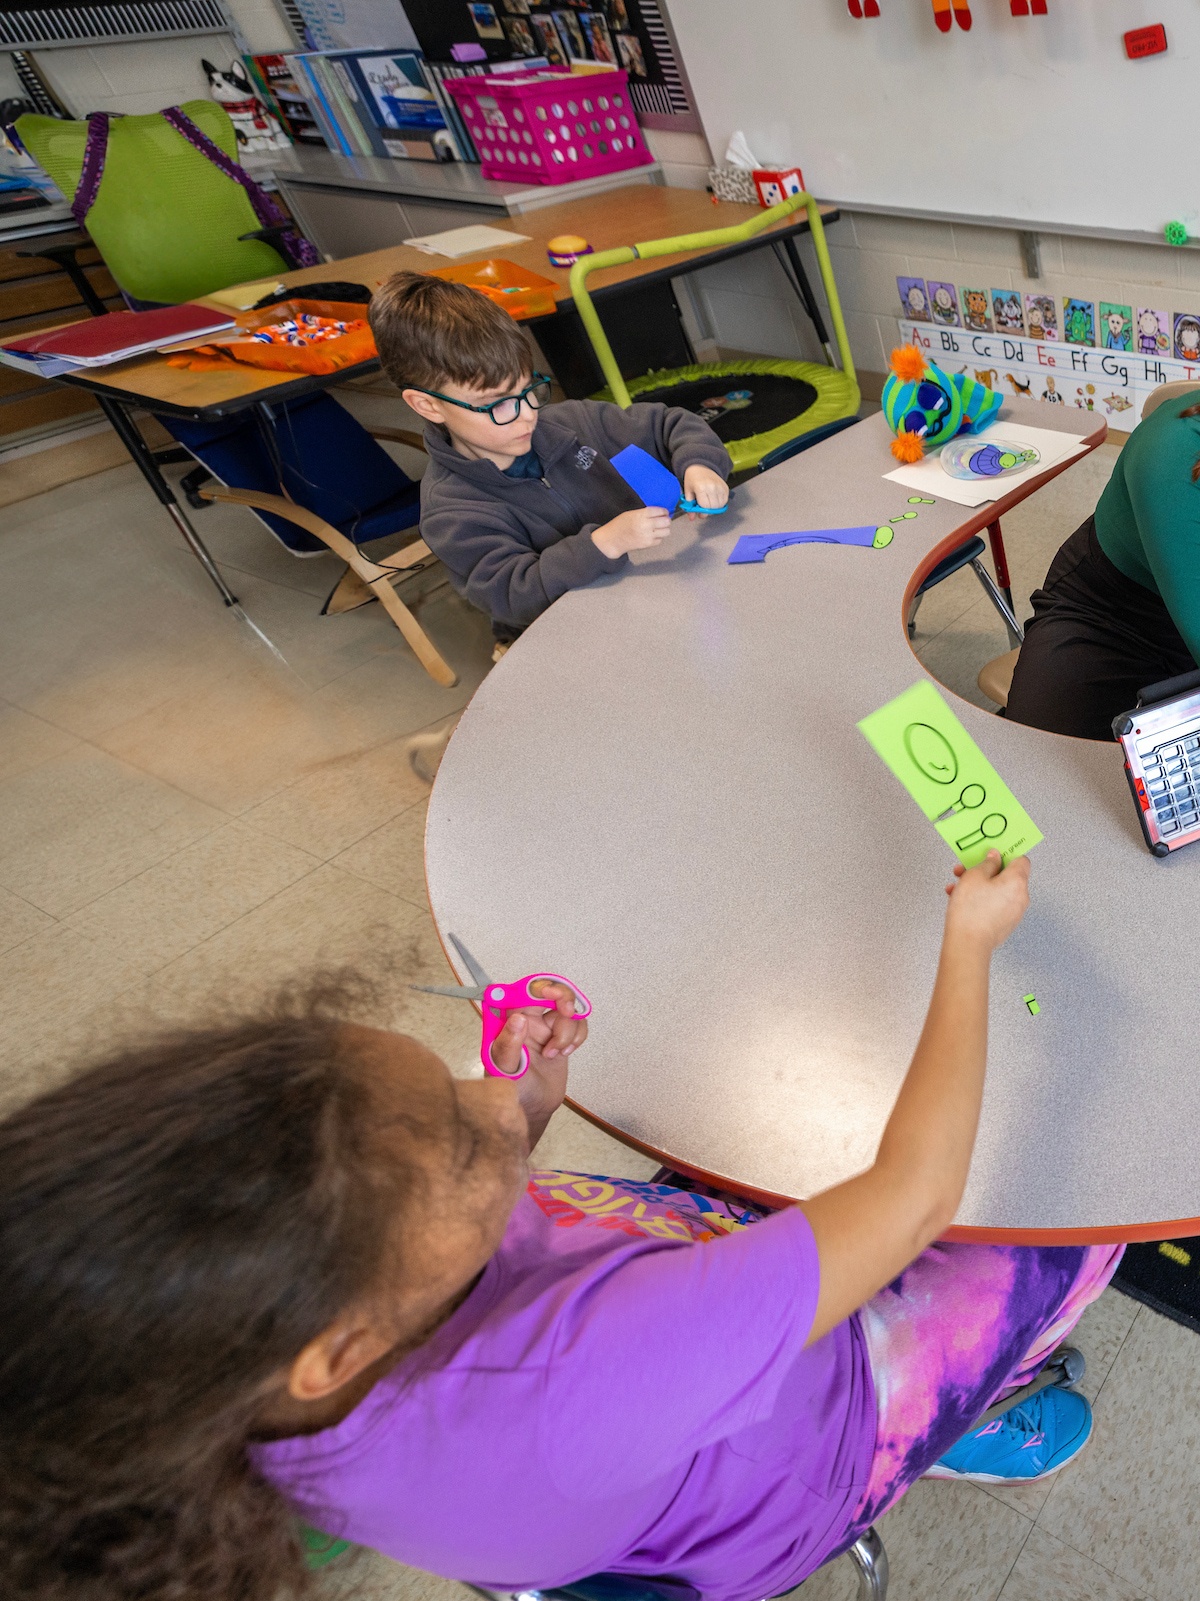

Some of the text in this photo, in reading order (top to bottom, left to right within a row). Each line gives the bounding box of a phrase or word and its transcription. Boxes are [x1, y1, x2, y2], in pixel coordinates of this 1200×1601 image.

[912, 327, 931, 348] Aa
[940, 331, 959, 352] Bb
[972, 336, 991, 357] Cc
[1003, 340, 1024, 362] Dd
[1037, 345, 1056, 367] Ee
[1071, 351, 1089, 372] Ff
[1101, 355, 1129, 387] Gg
[1144, 360, 1167, 383] Hh
[1008, 837, 1026, 854] green
